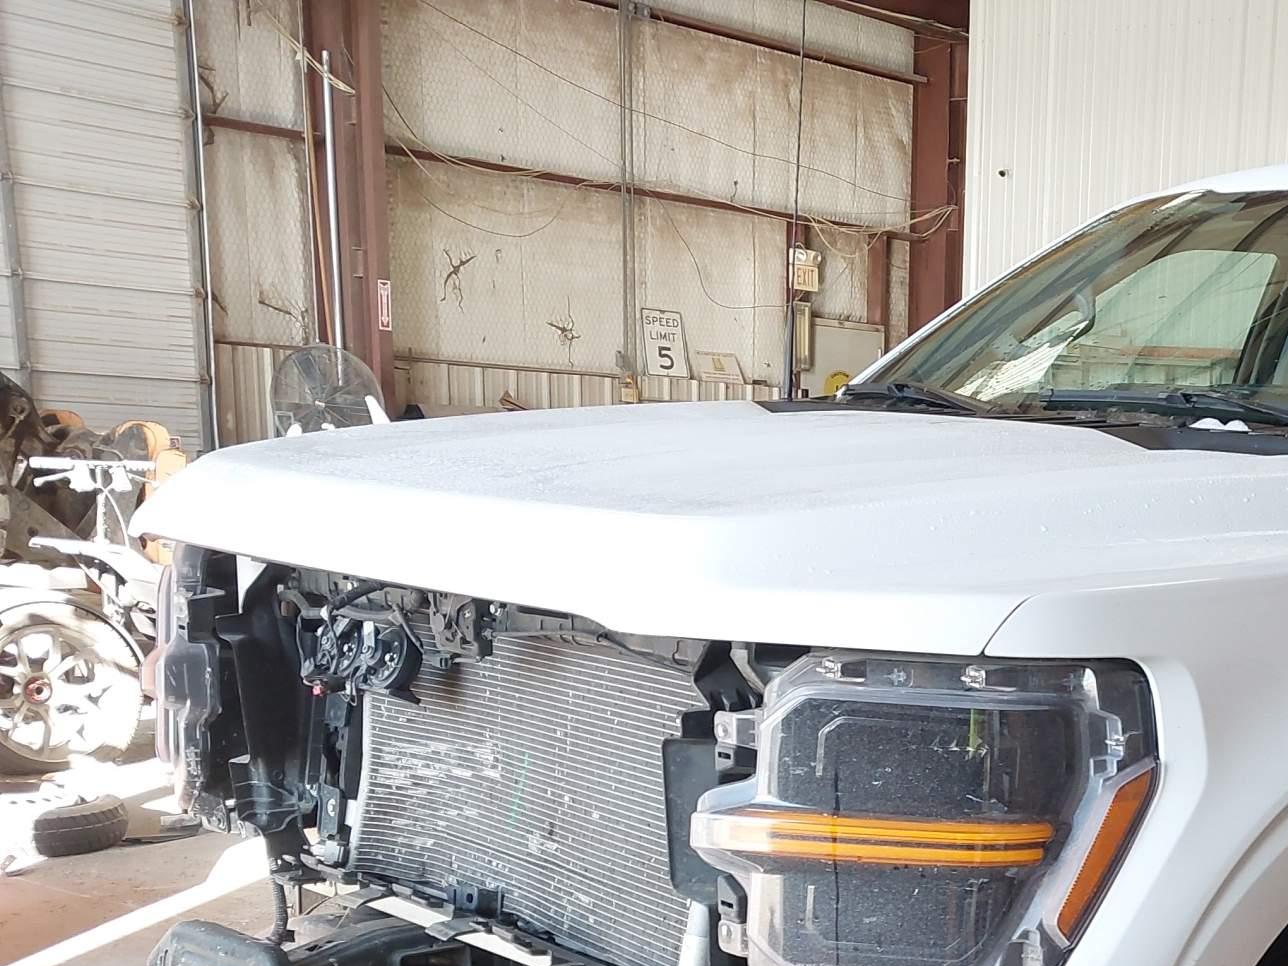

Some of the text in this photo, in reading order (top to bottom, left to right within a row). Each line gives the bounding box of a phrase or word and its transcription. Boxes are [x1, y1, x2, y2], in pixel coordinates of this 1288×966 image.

[796, 267, 815, 289] EXIT
[644, 315, 680, 329] SPEED
[649, 330, 678, 342] LIMIT
[657, 345, 675, 371] 5
